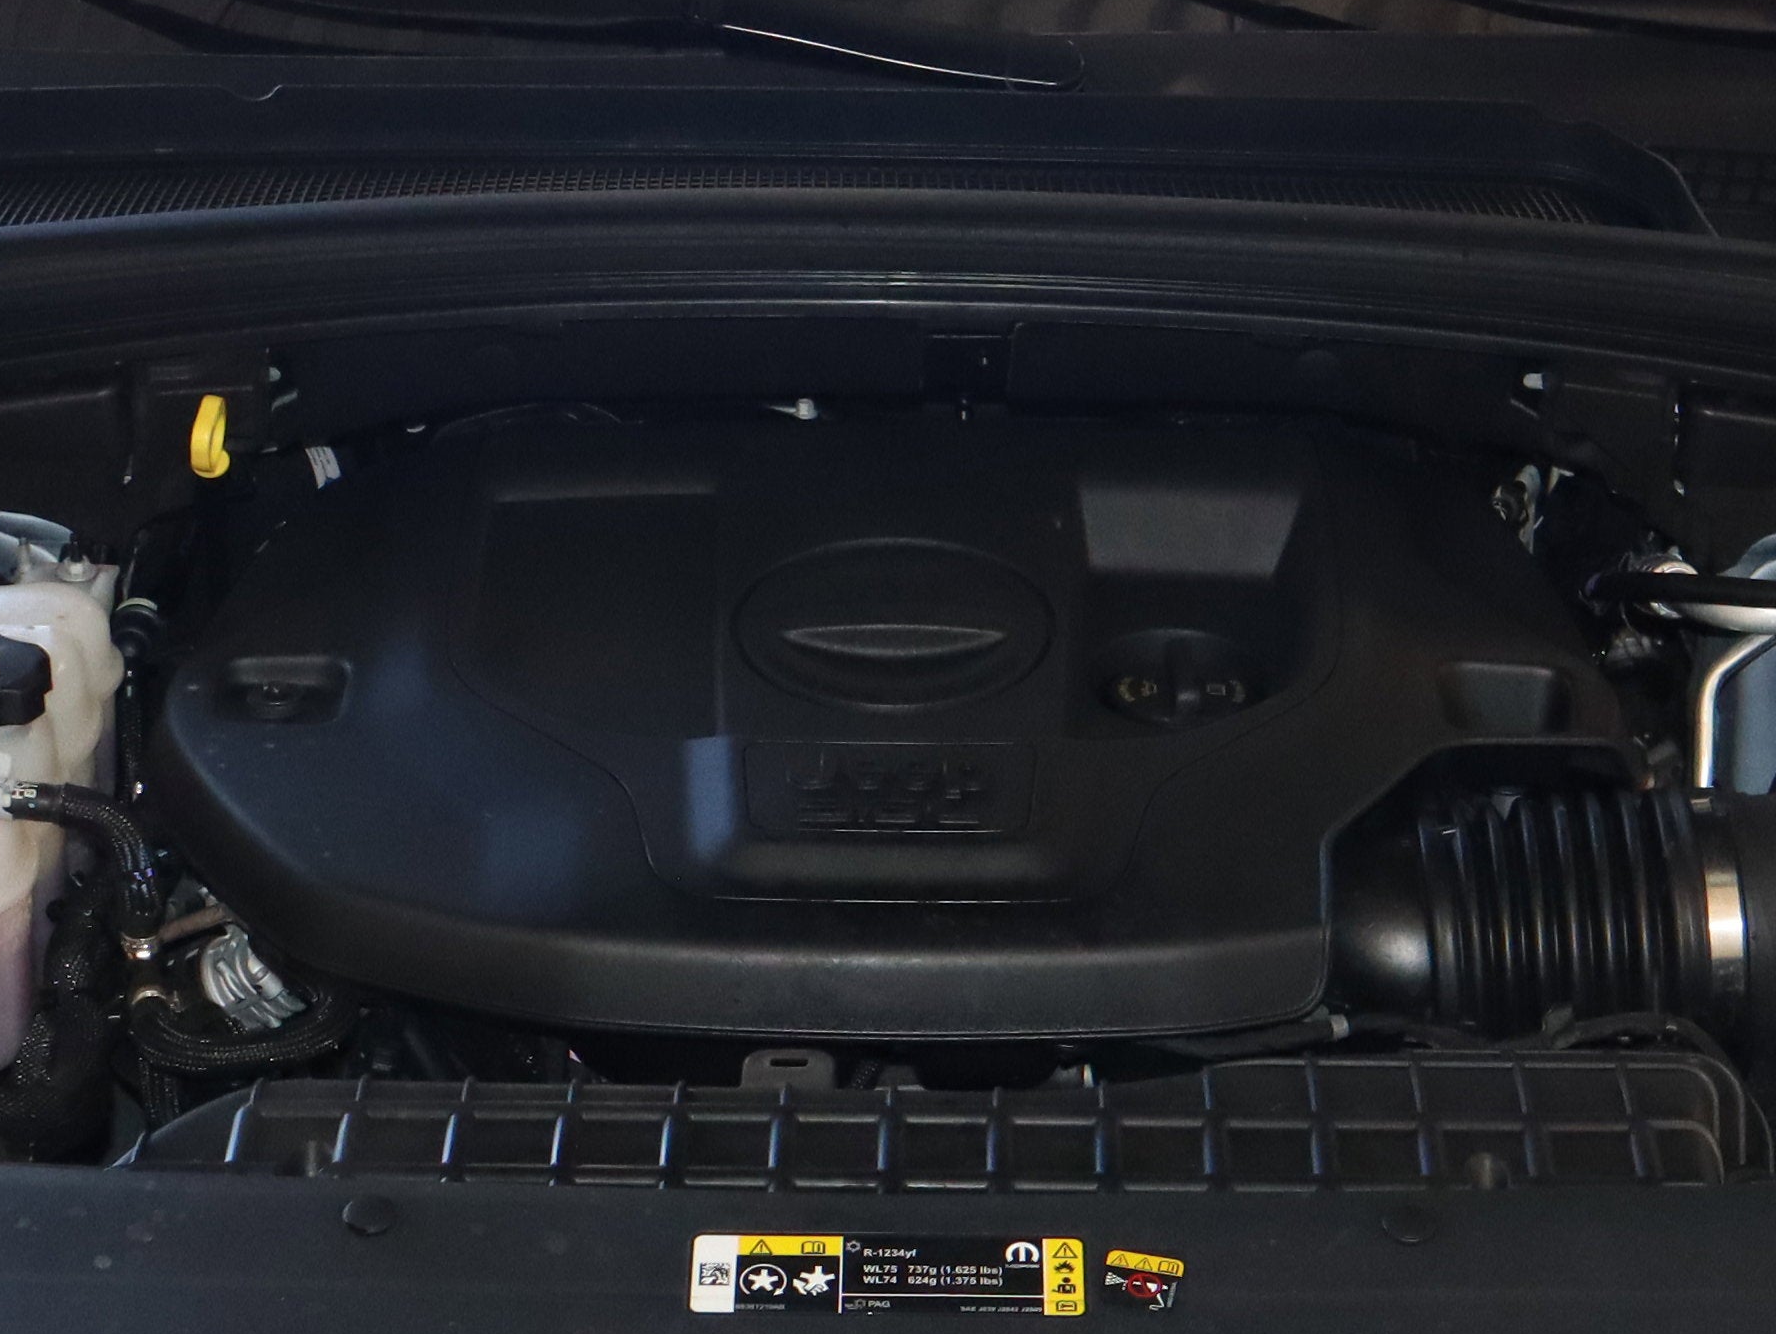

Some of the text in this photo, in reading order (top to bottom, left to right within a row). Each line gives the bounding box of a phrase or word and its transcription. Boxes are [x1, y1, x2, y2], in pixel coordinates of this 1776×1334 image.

[863, 1265, 898, 1274] WL75
[907, 1265, 937, 1275] 737g
[940, 1265, 977, 1275] (1.625
[980, 1265, 1003, 1275] lbs)
[863, 1276, 897, 1284] WL74
[907, 1276, 937, 1286] 624g
[980, 1276, 1003, 1286] lbs)
[868, 1300, 891, 1308] PAG
